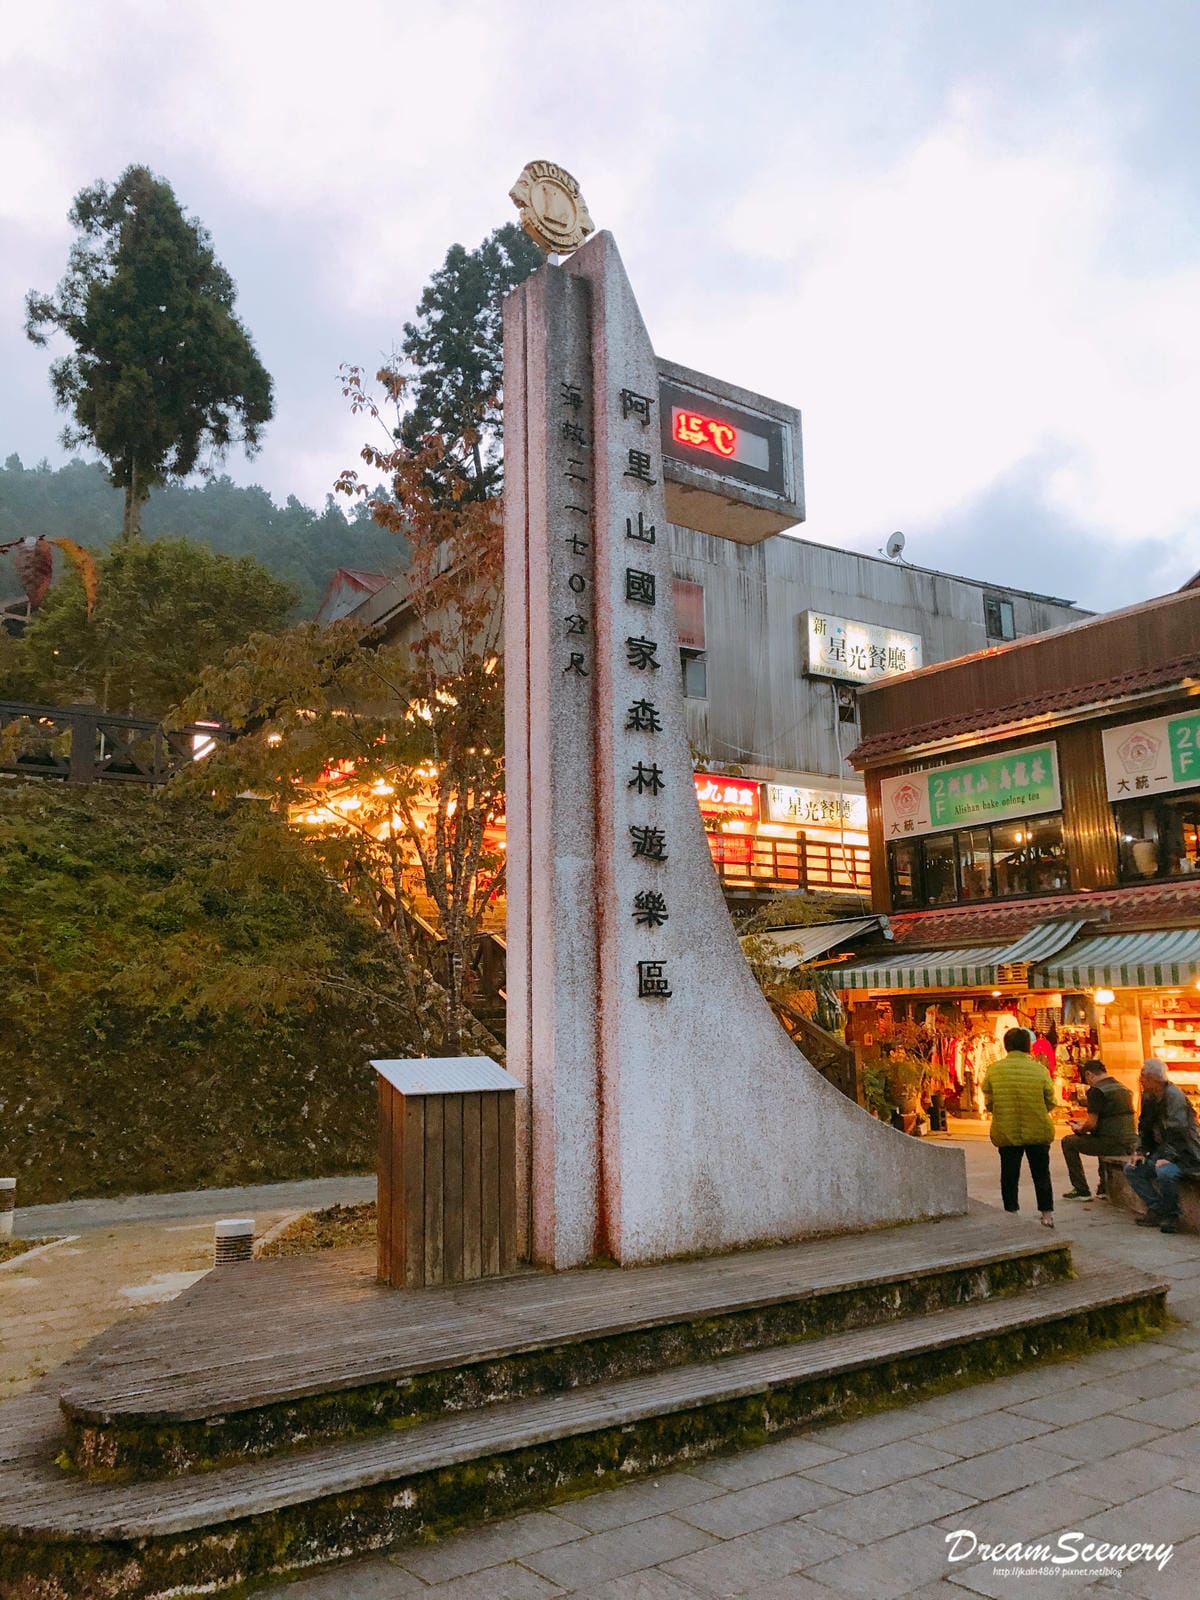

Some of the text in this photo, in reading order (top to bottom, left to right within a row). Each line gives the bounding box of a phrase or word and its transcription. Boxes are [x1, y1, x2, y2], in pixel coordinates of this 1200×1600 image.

[529, 163, 578, 197] LIONS
[619, 388, 673, 999] 阿里山國家森林遊樂區
[1117, 775, 1168, 793] 大統一
[954, 804, 980, 815] Alishan
[1028, 792, 1040, 801] tea
[891, 819, 928, 834] 大統一
